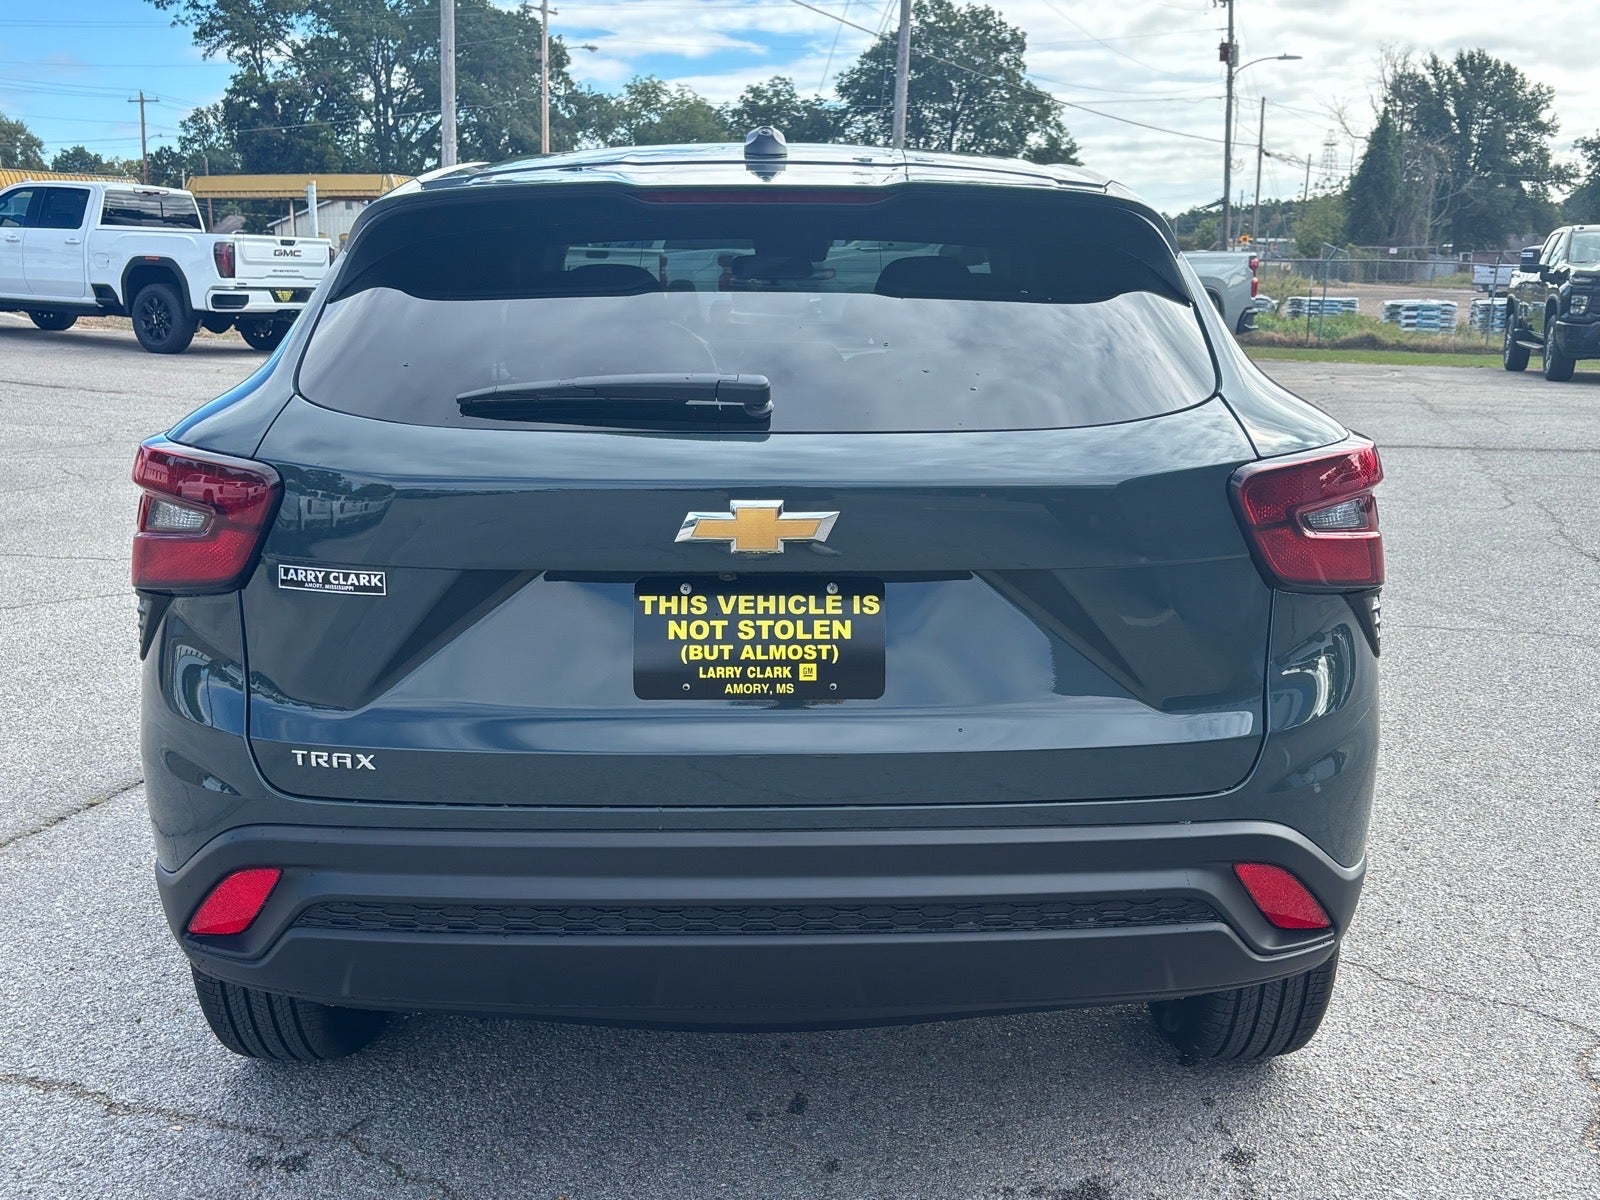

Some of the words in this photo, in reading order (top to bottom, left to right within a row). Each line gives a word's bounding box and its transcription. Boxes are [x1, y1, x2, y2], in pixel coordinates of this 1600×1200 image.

[273, 249, 302, 257] GMC
[280, 567, 326, 583] LARRY
[329, 572, 383, 587] CLARK
[304, 582, 324, 590] AMORY,
[324, 583, 355, 591] MISSISSIPPI
[639, 595, 708, 615] THIS
[717, 595, 843, 615] VEHICLE
[853, 595, 880, 615] IS
[668, 620, 728, 640] NOT
[737, 619, 852, 640] STOLEN
[681, 644, 734, 664] (BUT
[740, 644, 839, 664] ALMOST)
[699, 666, 742, 679] LARRY
[747, 666, 792, 679] CLARK
[724, 683, 773, 695] AMORY,
[776, 683, 795, 694] MS
[291, 749, 376, 771] TRAX
